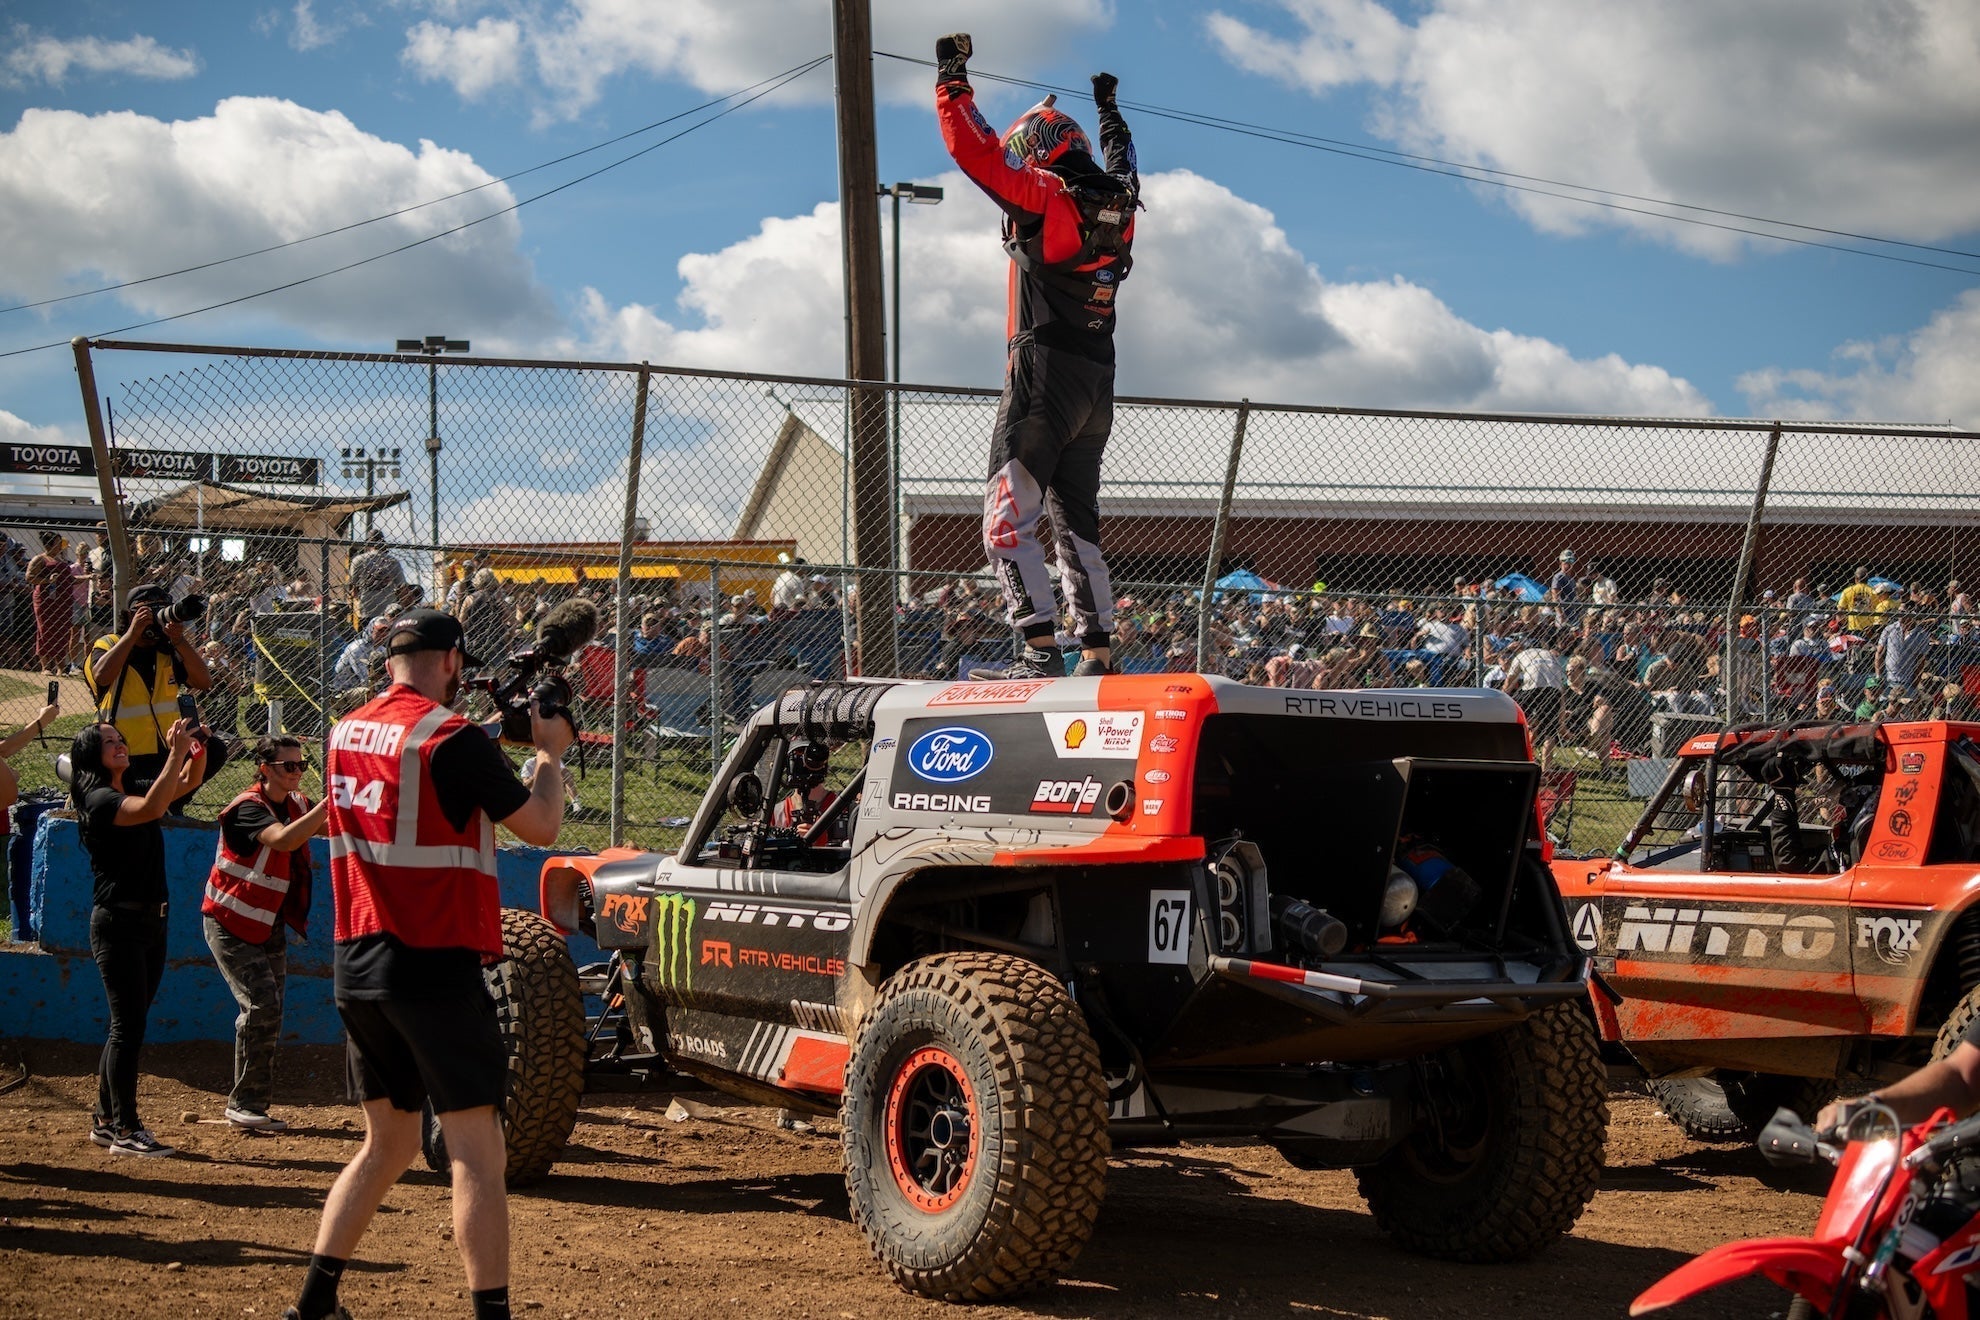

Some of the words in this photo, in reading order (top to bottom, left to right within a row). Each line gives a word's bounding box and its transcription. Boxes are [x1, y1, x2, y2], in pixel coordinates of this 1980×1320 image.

[10, 446, 81, 464] TOYOTA
[128, 452, 196, 470] TOYOTA
[236, 457, 301, 475] TOYOTA
[12, 463, 81, 473] RACING
[1285, 697, 1337, 715] RTR
[1341, 699, 1463, 719] VEHICLES
[1098, 726, 1134, 737] V-Power
[1099, 717, 1113, 725] Shell
[329, 719, 406, 757] MEDIA
[922, 734, 978, 773] Ford
[893, 792, 992, 813] RACING
[1878, 842, 1910, 858] Ford
[600, 893, 650, 923] FOX
[702, 901, 852, 932] NITTO
[1154, 898, 1187, 952] 67
[1615, 906, 1836, 961] NITTO
[1855, 917, 1923, 952] FOX
[738, 948, 769, 968] RTR
[770, 953, 846, 978] VEHICLES
[685, 1034, 727, 1059] ROADS
